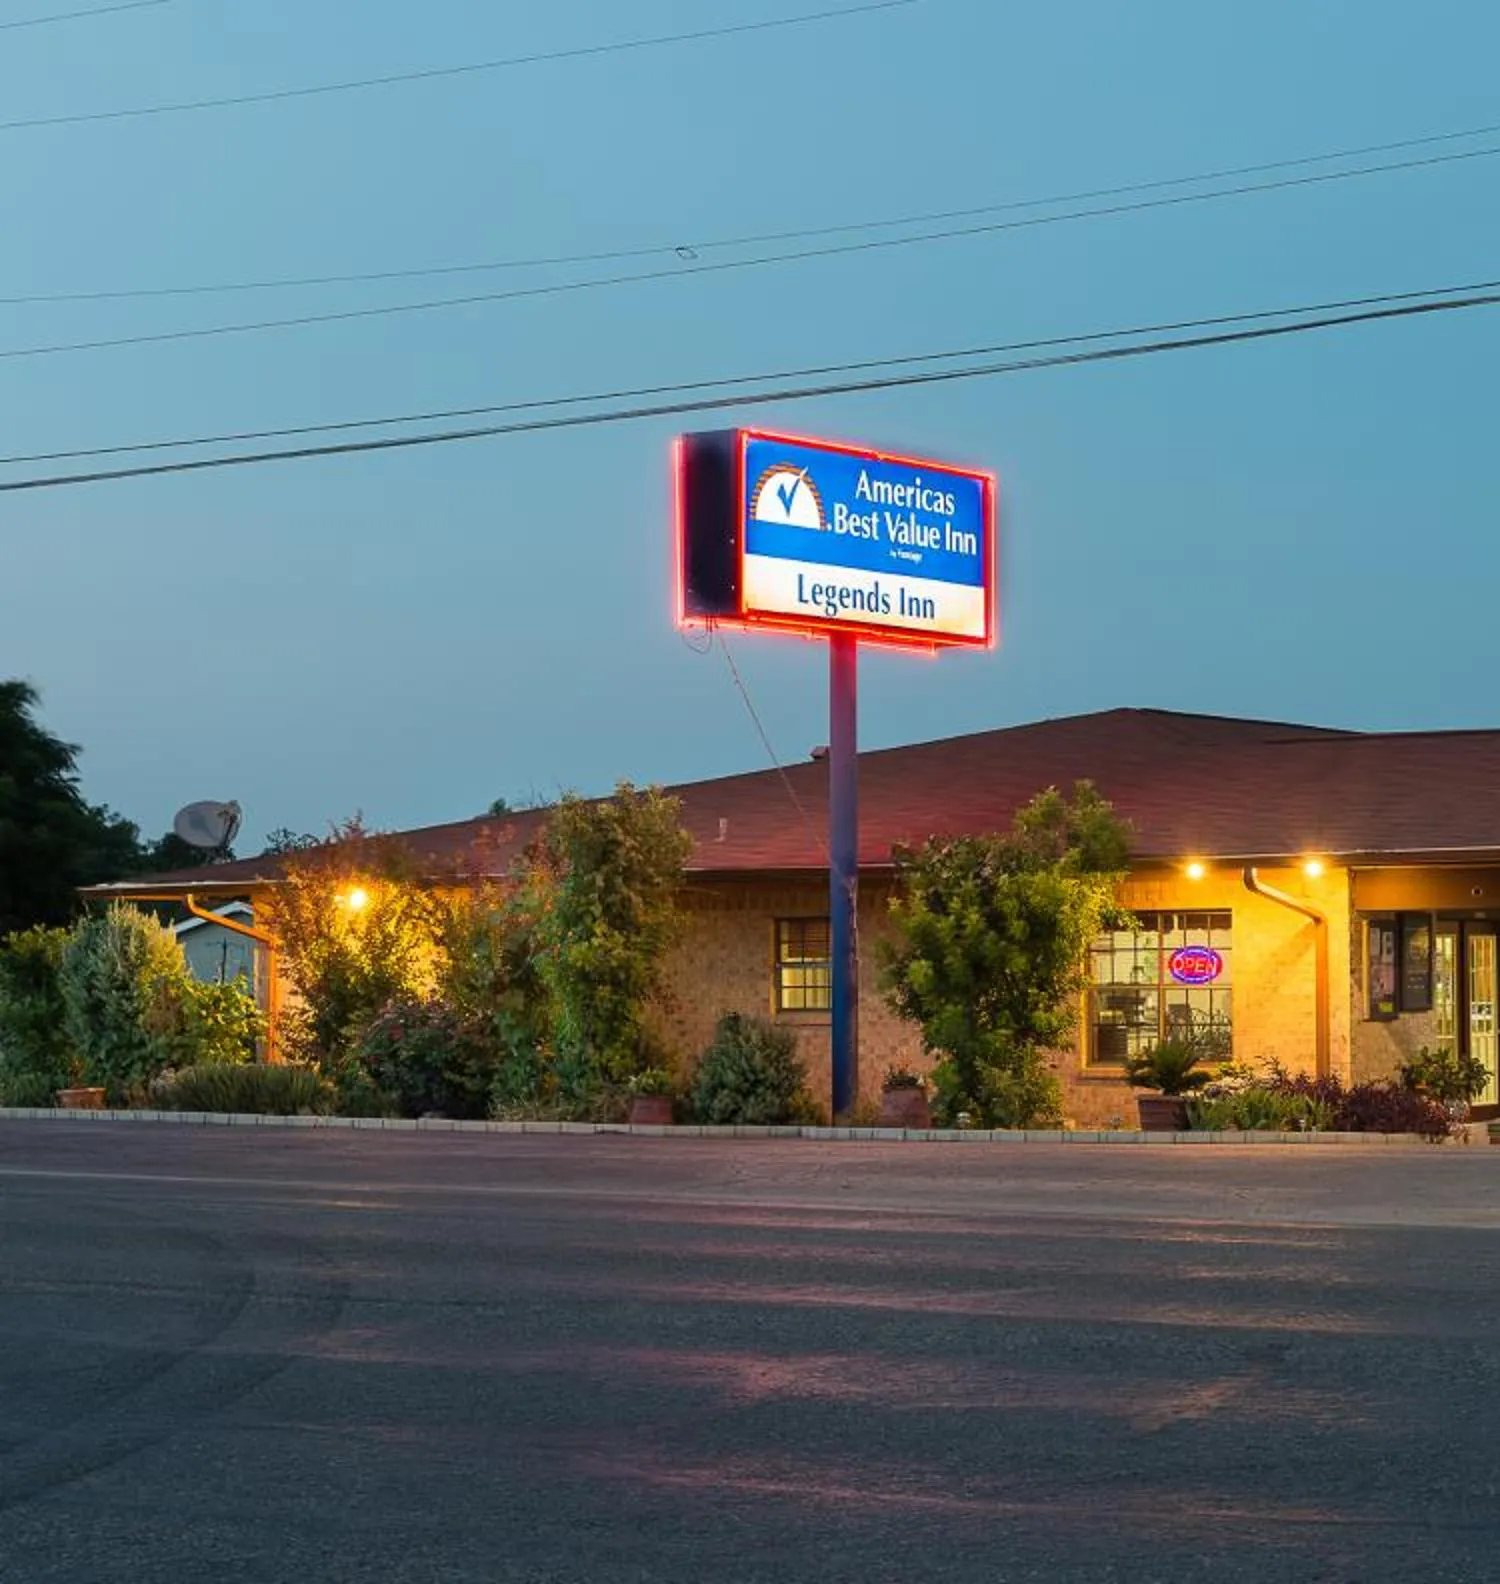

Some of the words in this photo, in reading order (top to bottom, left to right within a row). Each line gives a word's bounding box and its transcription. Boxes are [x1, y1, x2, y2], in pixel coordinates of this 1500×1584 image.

[855, 469, 955, 516] Americas
[833, 503, 880, 541] Best
[884, 511, 941, 550] Value
[945, 521, 977, 556] Inn
[797, 573, 891, 617] Legends
[899, 587, 935, 619] Inn
[1172, 957, 1217, 976] OPEN
